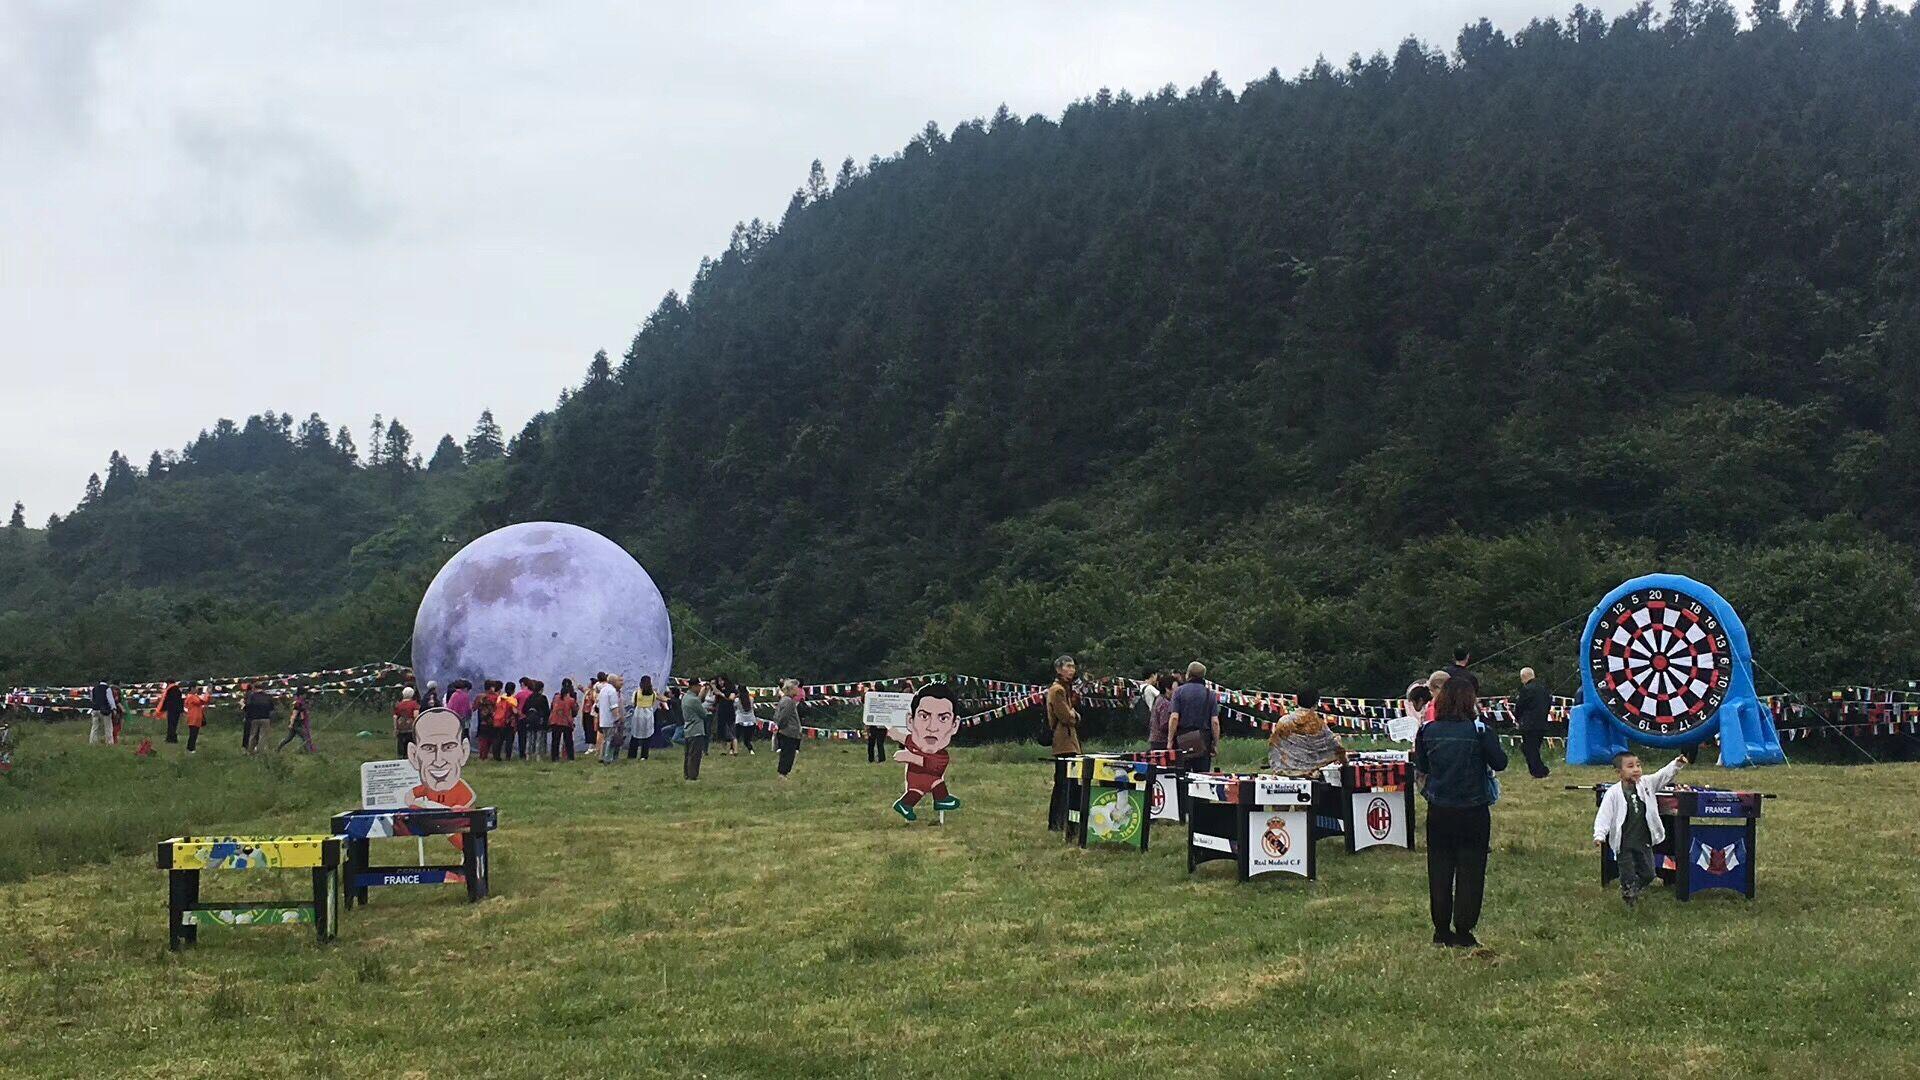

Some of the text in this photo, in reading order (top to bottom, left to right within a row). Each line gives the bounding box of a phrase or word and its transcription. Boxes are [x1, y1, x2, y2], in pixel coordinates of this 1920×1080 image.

[1631, 594, 1640, 604] 5
[1649, 590, 1662, 600] 20
[1674, 594, 1679, 603] 1
[1612, 602, 1626, 616] 12
[1690, 602, 1702, 614] 18
[1600, 621, 1610, 630] 9
[1593, 638, 1604, 651] 14
[1715, 634, 1727, 648] 13
[1593, 659, 1602, 670] 11
[1720, 657, 1730, 666] 6
[1597, 680, 1607, 688] 8
[1718, 675, 1729, 688] 10
[1709, 693, 1721, 707] 15
[1622, 712, 1631, 721] 7
[1697, 710, 1707, 720] 2
[1638, 720, 1652, 731] 19
[1660, 723, 1668, 733] 3
[1679, 719, 1692, 731] 17
[1705, 806, 1732, 814] FRANCE
[384, 875, 420, 885] FRANCE
